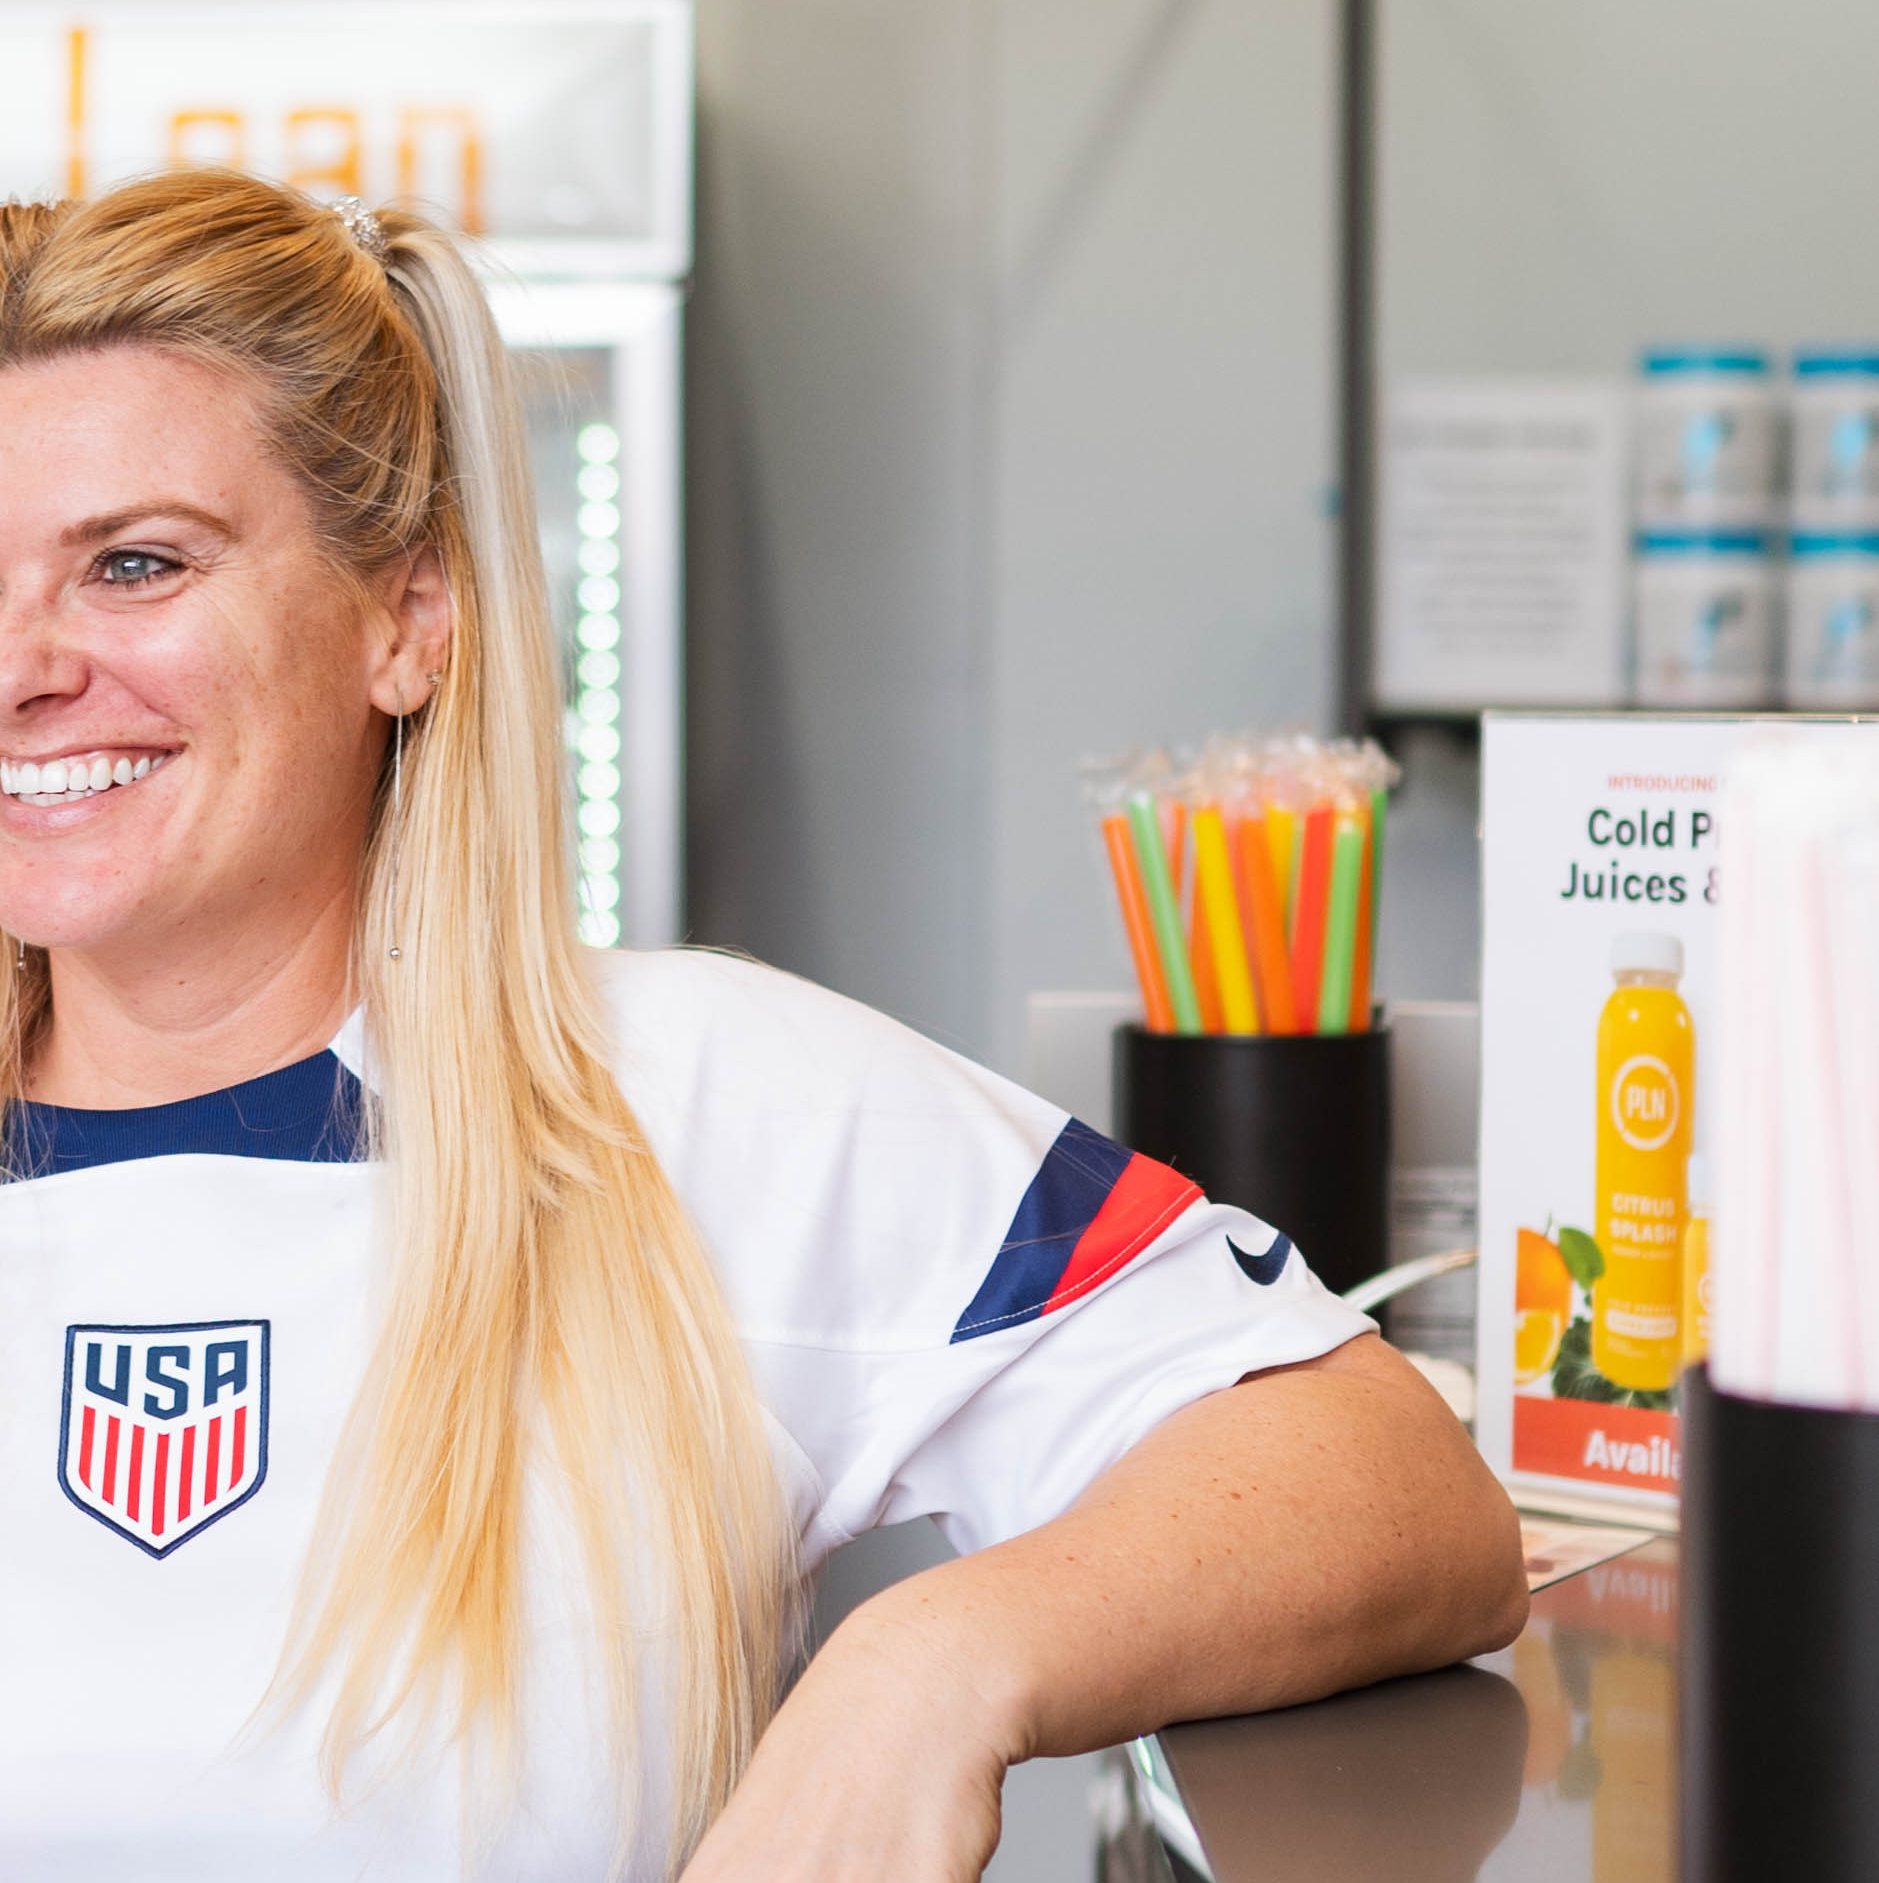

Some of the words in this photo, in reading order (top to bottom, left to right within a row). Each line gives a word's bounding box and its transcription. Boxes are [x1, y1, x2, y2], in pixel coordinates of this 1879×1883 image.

[1588, 808, 1674, 848] Cold
[1691, 811, 1718, 849] P
[1561, 860, 1687, 903] Juices
[1626, 1085, 1667, 1121] PLN
[1612, 1192, 1675, 1218] CITRUS
[1610, 1217, 1678, 1245] SPLASH
[85, 1339, 248, 1420] USA
